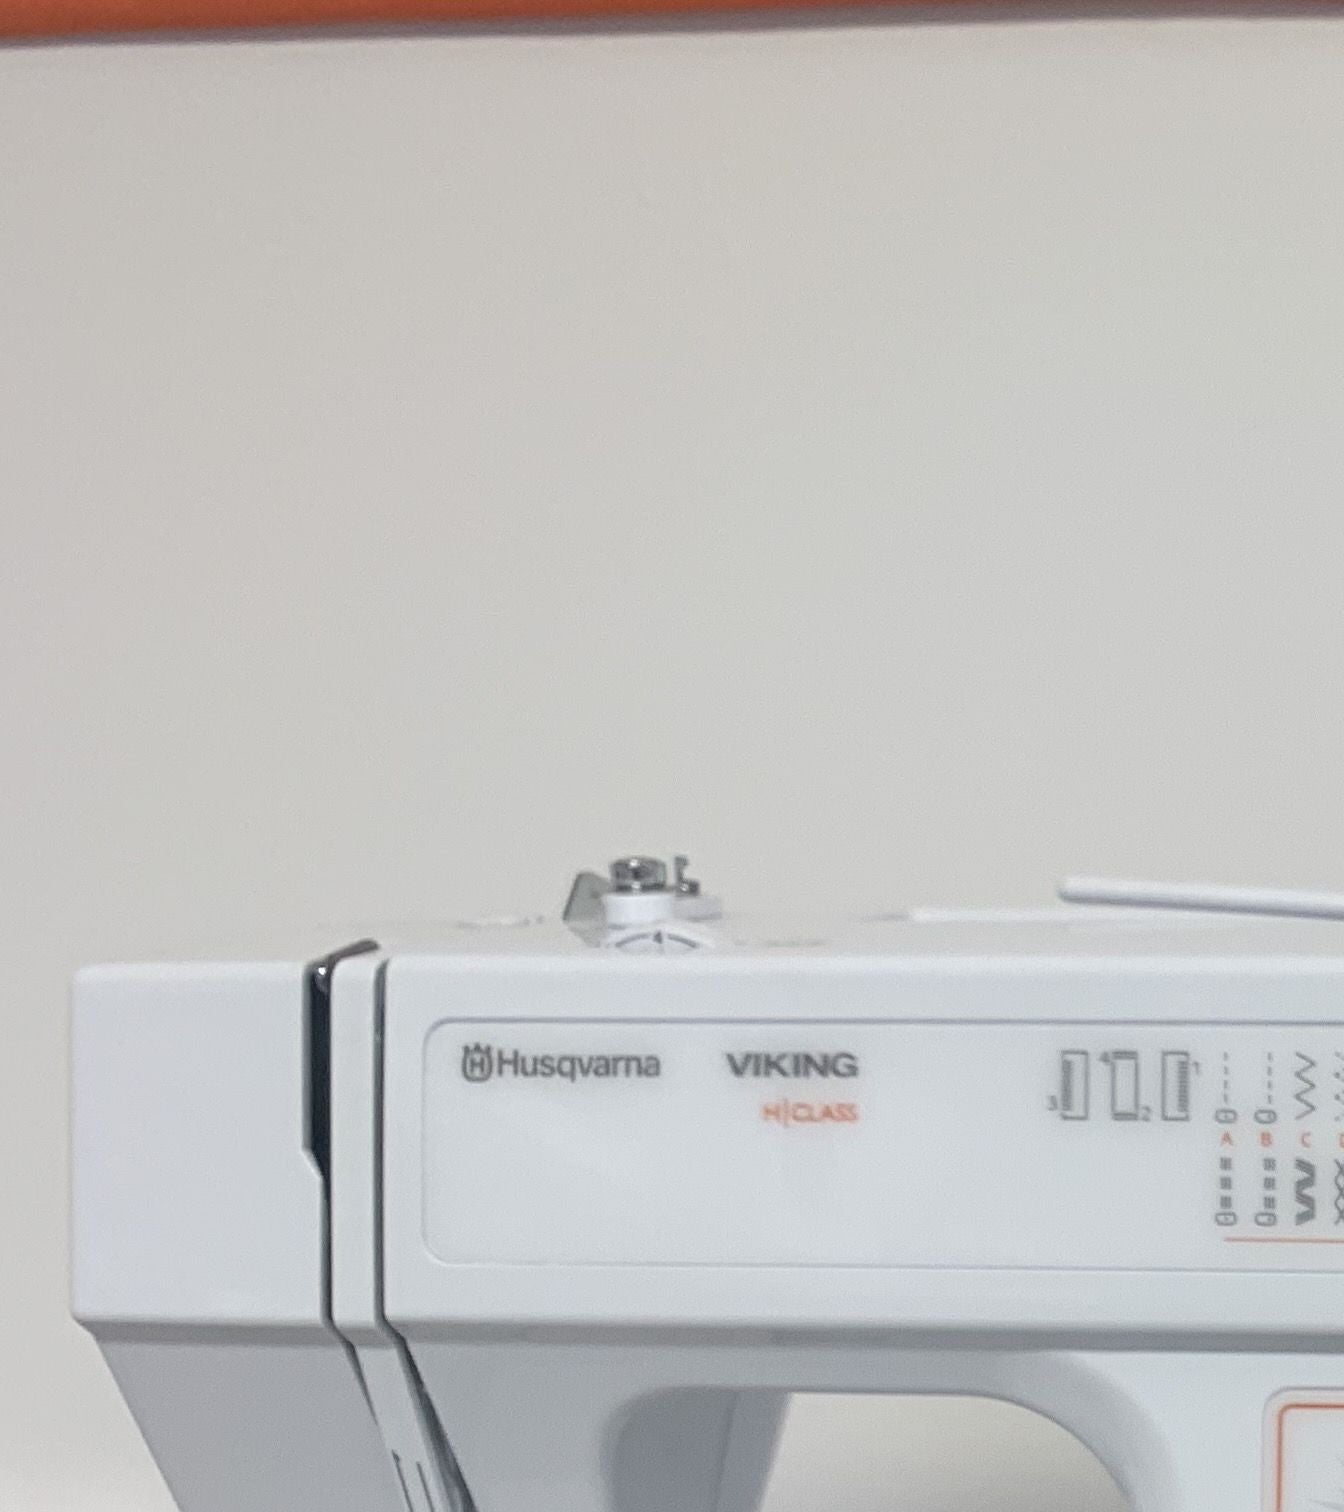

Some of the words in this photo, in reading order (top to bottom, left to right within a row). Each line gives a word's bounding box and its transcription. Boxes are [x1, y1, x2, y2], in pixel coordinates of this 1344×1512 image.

[497, 1049, 661, 1083] Husqvarna
[725, 1052, 859, 1078] VIKING
[1221, 1132, 1233, 1147] A
[1260, 1132, 1273, 1148] B
[1300, 1132, 1311, 1149] C
